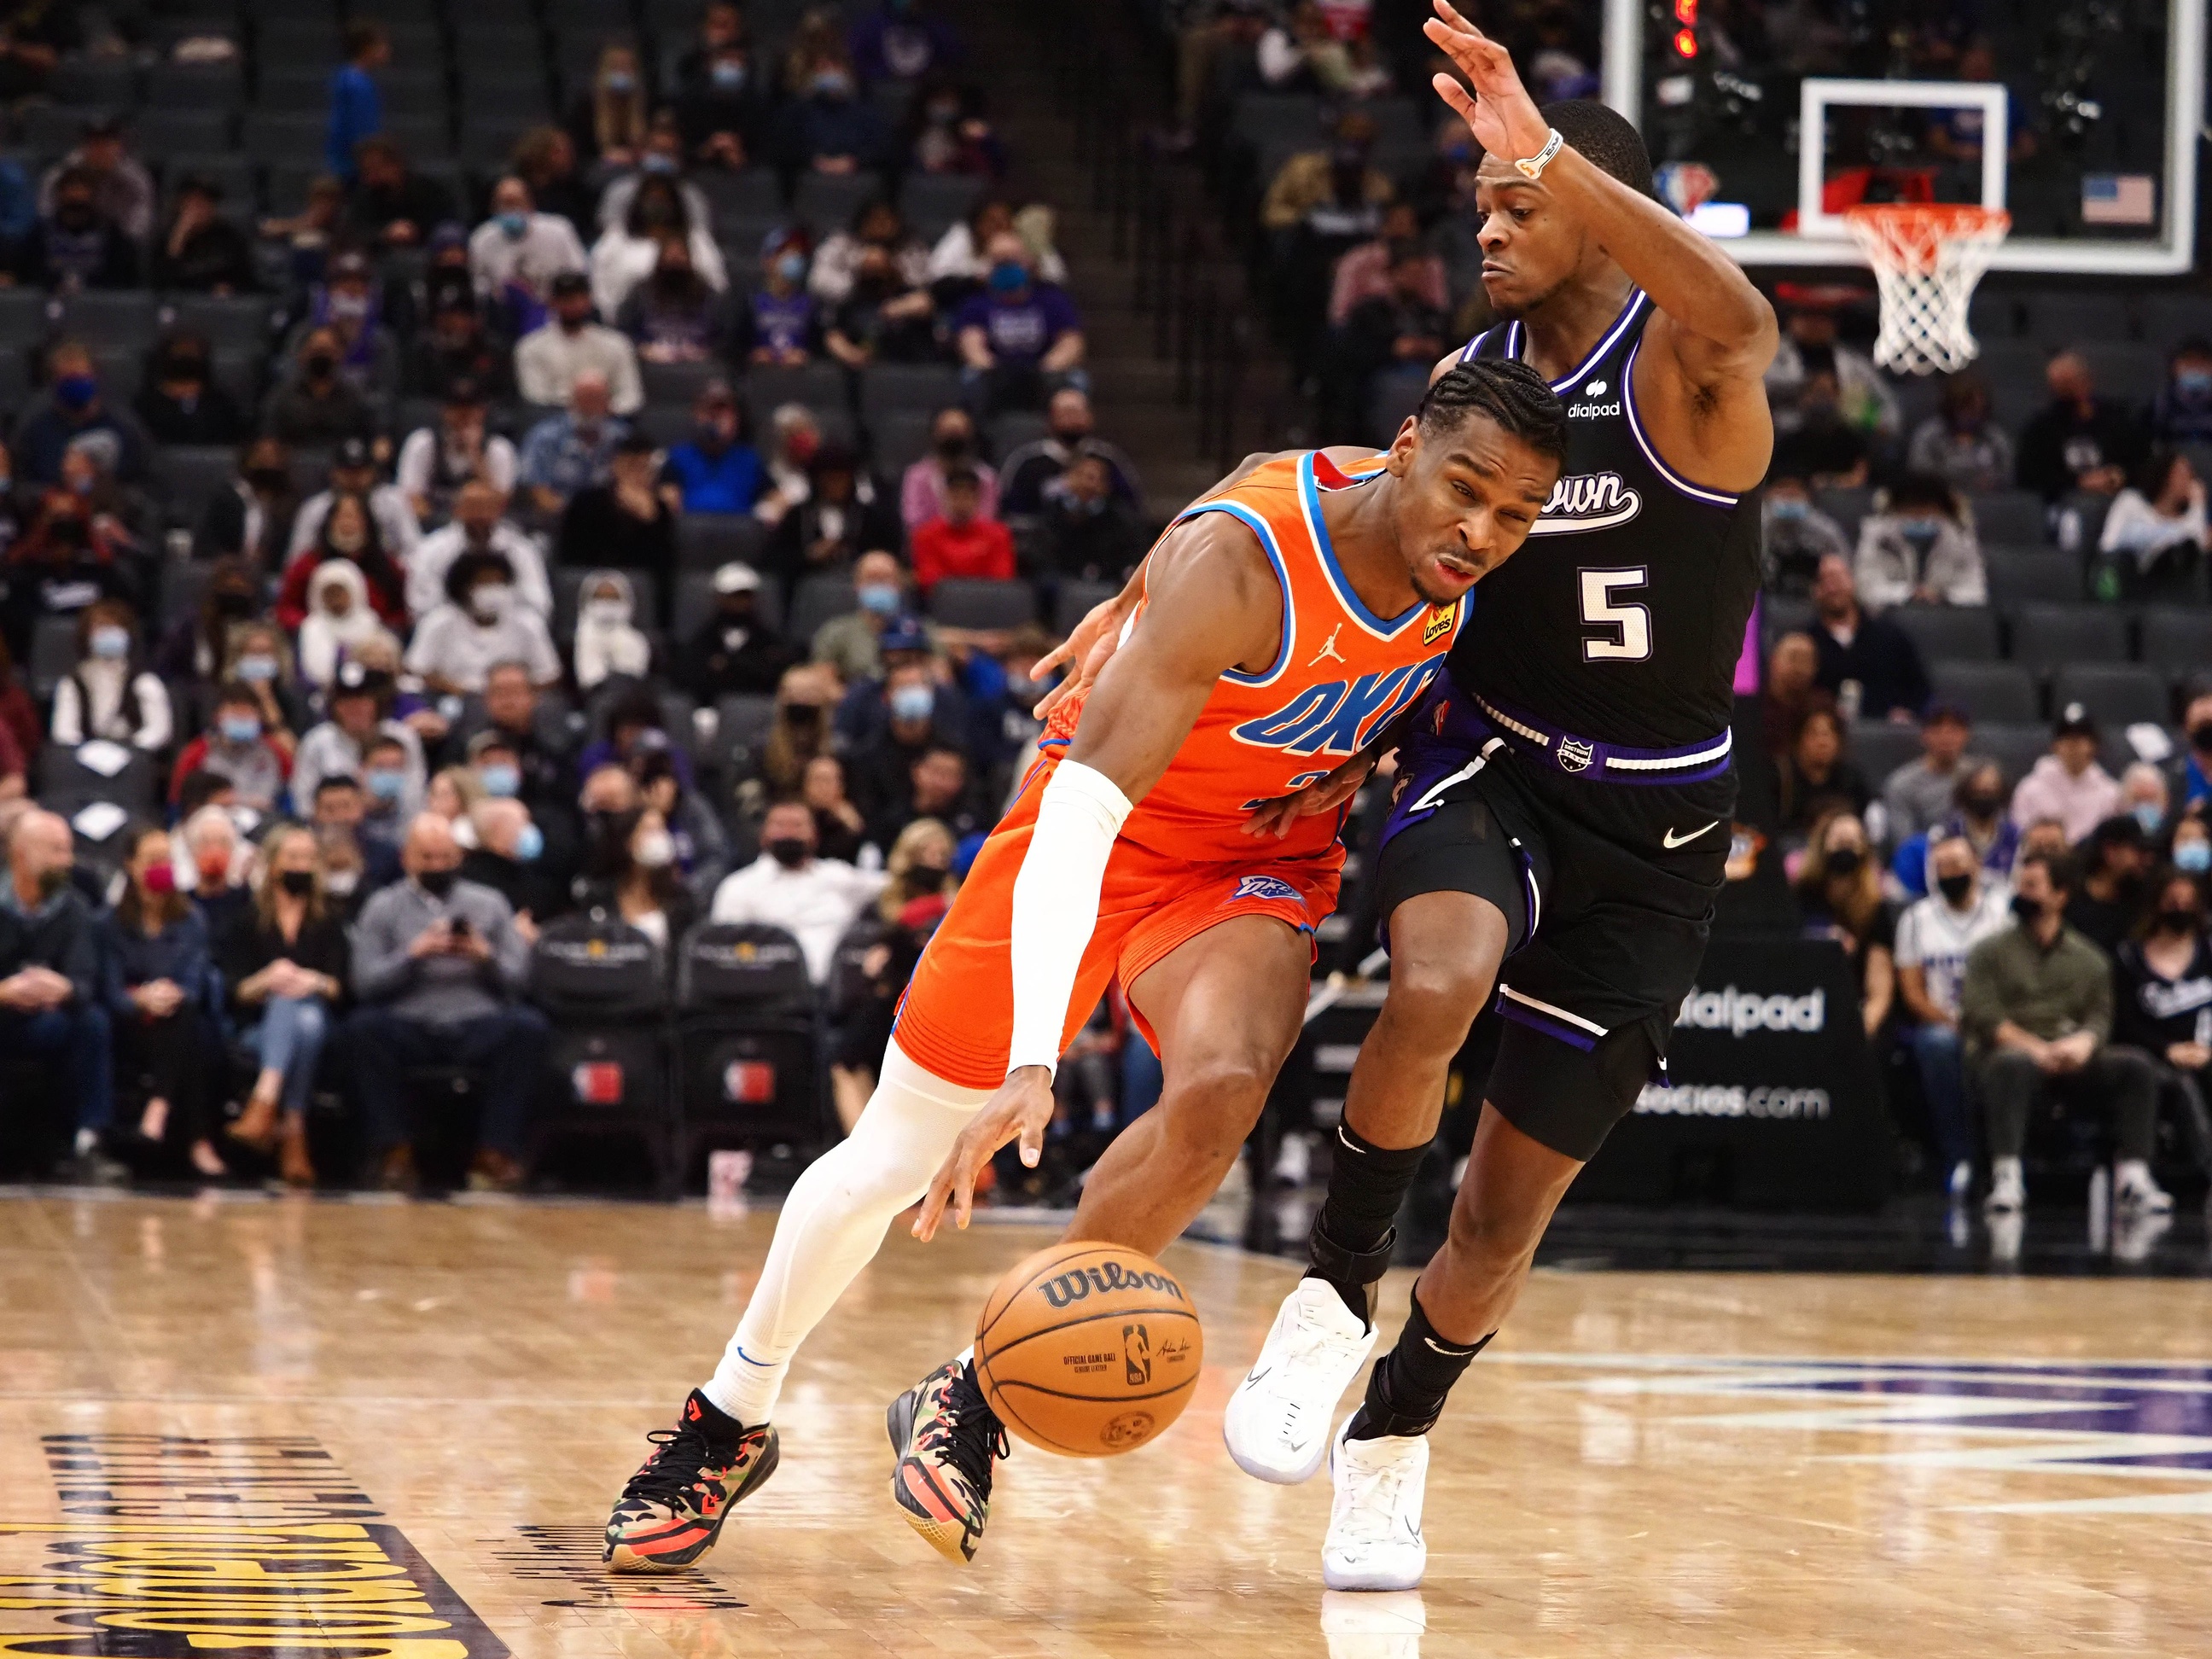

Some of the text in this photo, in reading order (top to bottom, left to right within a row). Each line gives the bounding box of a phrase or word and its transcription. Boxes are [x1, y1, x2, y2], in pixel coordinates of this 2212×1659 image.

[1568, 401, 1620, 420] dialpad
[1577, 565, 1653, 662] 5
[1425, 614, 1451, 640] Love's
[1229, 651, 1447, 756] OKC
[1037, 1260, 1185, 1309] Wilson
[1063, 1352, 1116, 1365] OFFICIAL GAME BALL
[1129, 1372, 1142, 1383] NBA
